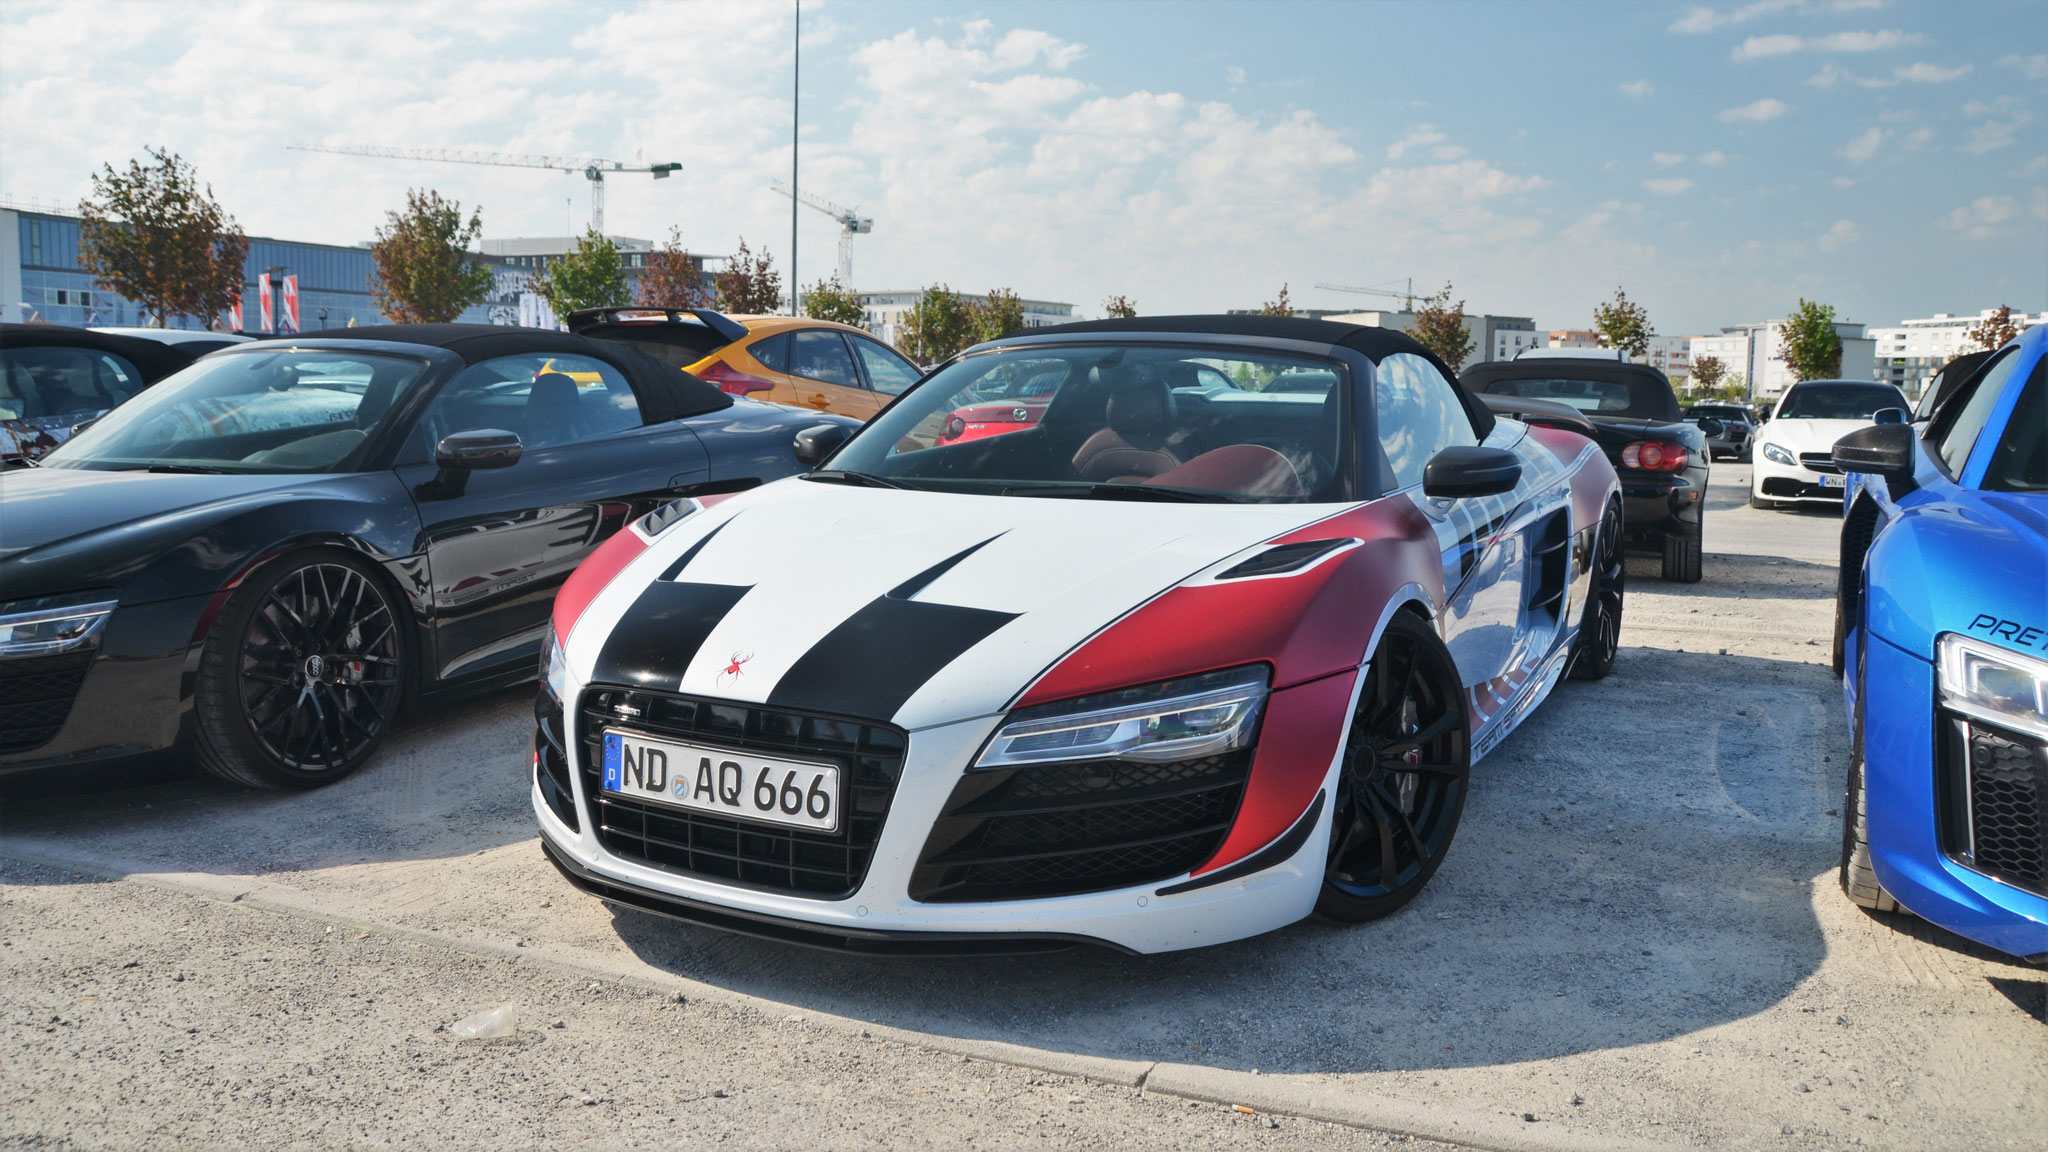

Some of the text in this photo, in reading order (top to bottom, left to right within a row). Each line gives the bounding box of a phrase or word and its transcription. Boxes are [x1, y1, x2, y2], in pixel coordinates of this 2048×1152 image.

[608, 768, 616, 781] D
[623, 744, 831, 819] ND AQ 666
